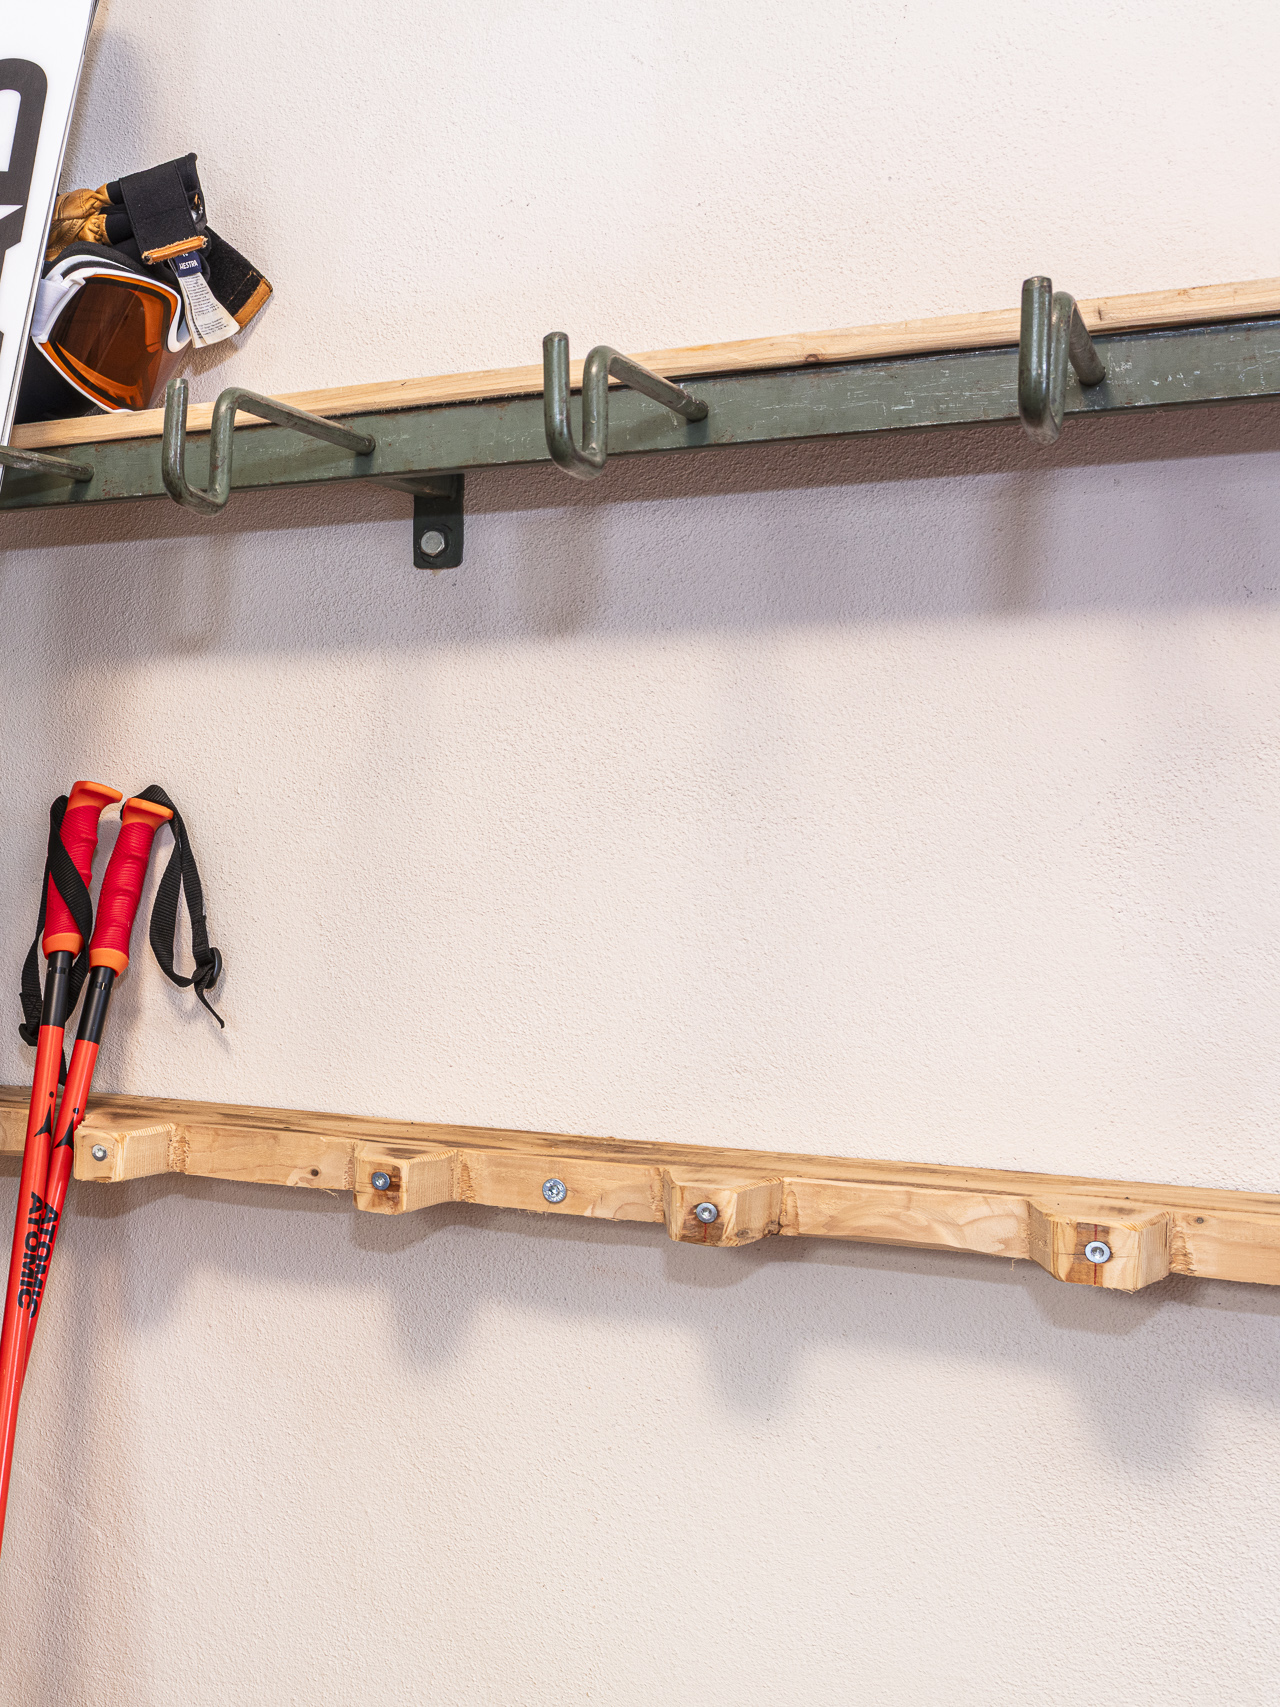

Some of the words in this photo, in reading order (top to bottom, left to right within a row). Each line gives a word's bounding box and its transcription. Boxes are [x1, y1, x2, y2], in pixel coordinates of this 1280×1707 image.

[179, 260, 199, 270] HESTRA
[17, 1191, 43, 1310] ATOMIC
[29, 1202, 59, 1319] ATOMIC
